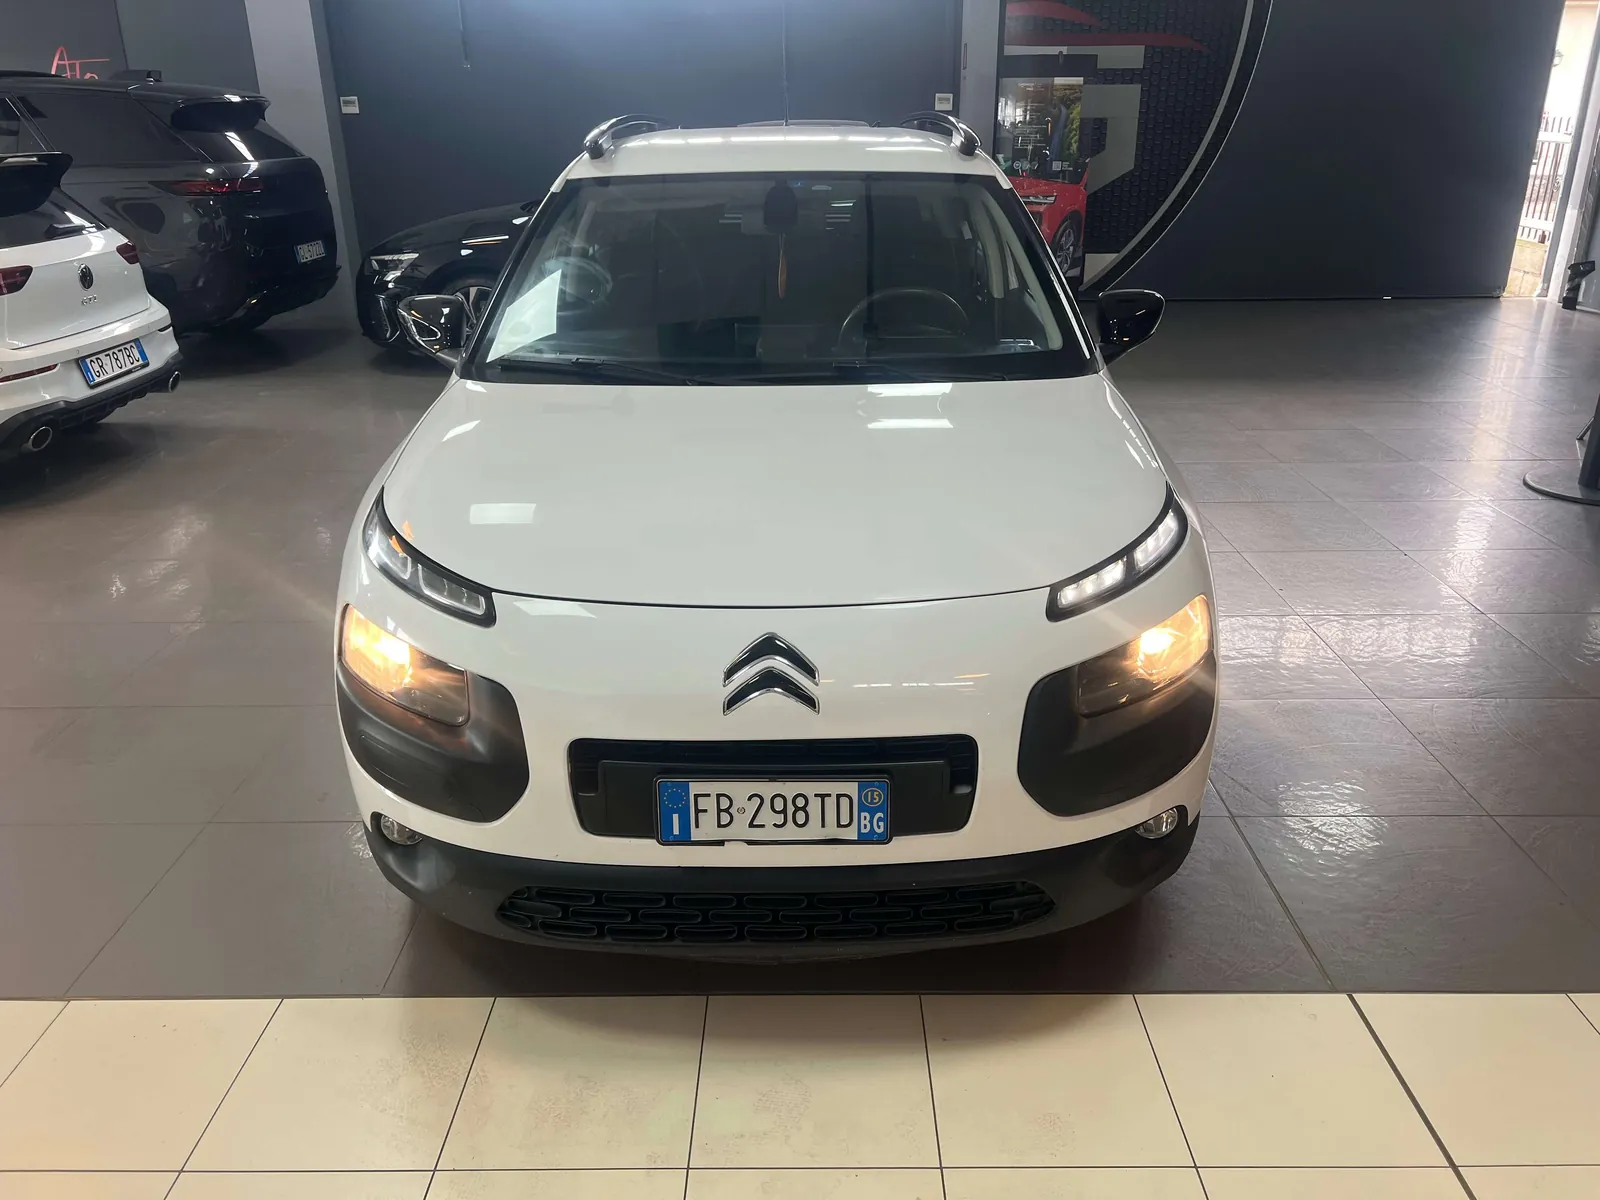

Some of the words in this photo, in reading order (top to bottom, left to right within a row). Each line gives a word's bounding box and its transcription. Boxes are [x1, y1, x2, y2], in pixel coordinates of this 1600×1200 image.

[90, 357, 108, 378] GR
[105, 345, 140, 372] 787BC
[867, 791, 880, 803] 15
[693, 793, 734, 829] FB
[746, 793, 854, 829] 298TD
[860, 811, 884, 834] BG
[672, 813, 680, 835] I
